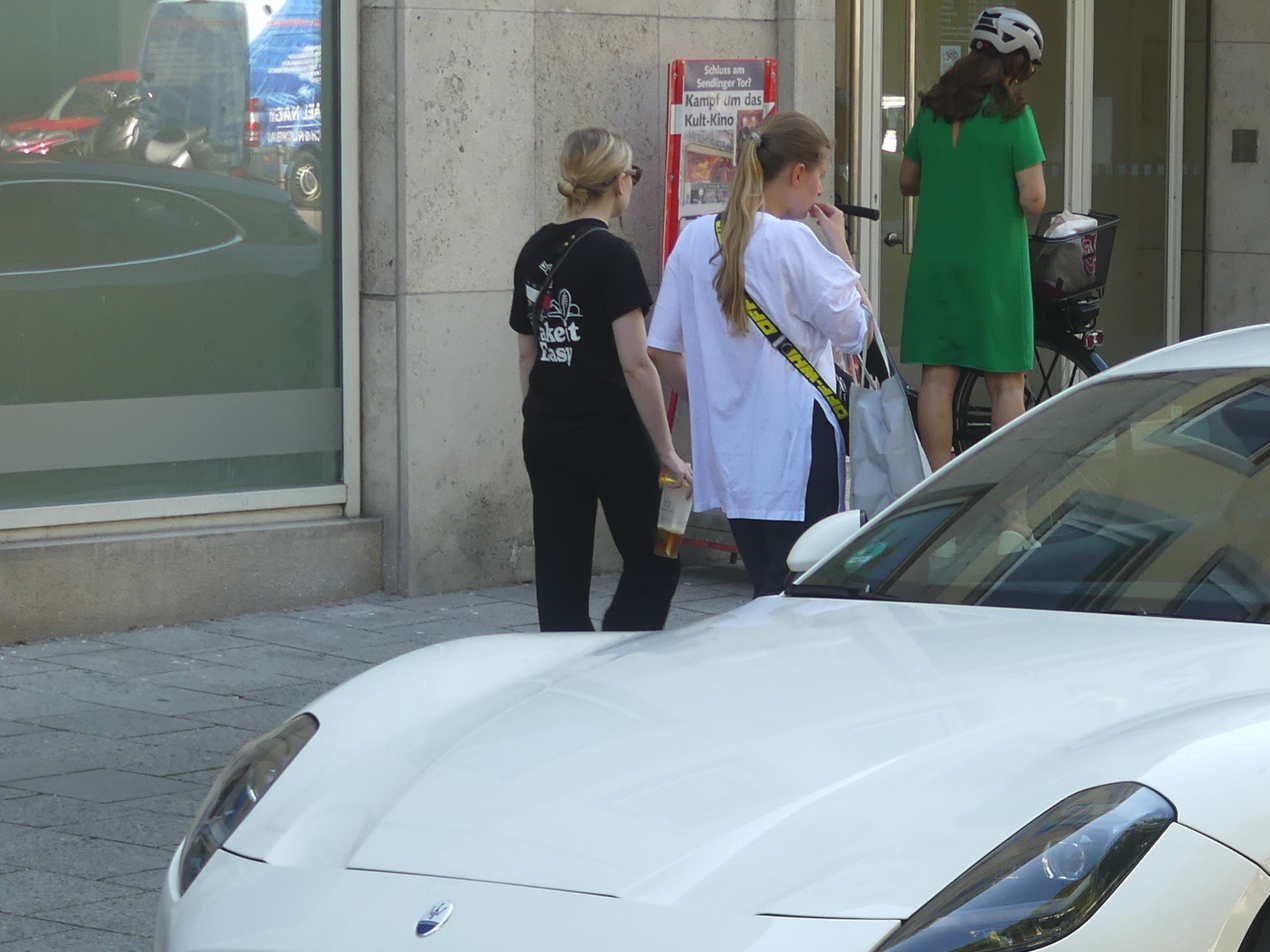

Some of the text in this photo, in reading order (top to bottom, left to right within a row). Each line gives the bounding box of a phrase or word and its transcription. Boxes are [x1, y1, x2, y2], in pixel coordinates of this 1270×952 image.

[704, 64, 745, 75] Schluss am
[696, 78, 752, 90] Sendlinger Tor?
[685, 92, 762, 111] Kampf um das
[684, 113, 734, 127] Kult-Kino
[539, 341, 573, 367] Easy
